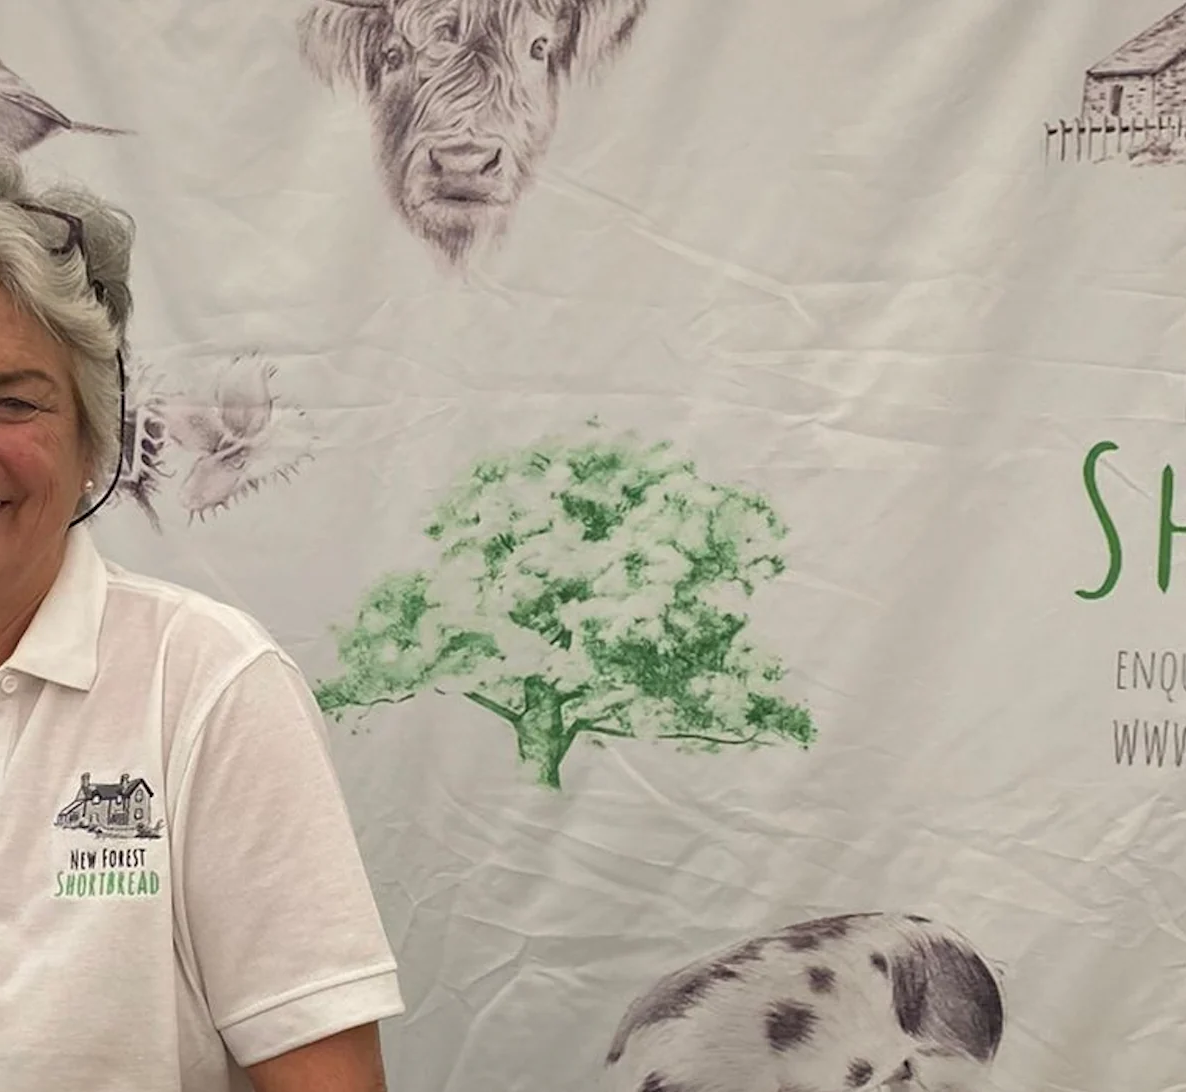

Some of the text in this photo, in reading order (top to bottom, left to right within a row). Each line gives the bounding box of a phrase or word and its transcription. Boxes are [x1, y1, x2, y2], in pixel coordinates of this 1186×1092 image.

[1116, 650, 1186, 701] ENQ
[70, 848, 146, 870] NEW FOREST
[53, 871, 160, 897] SHORTBREAD
